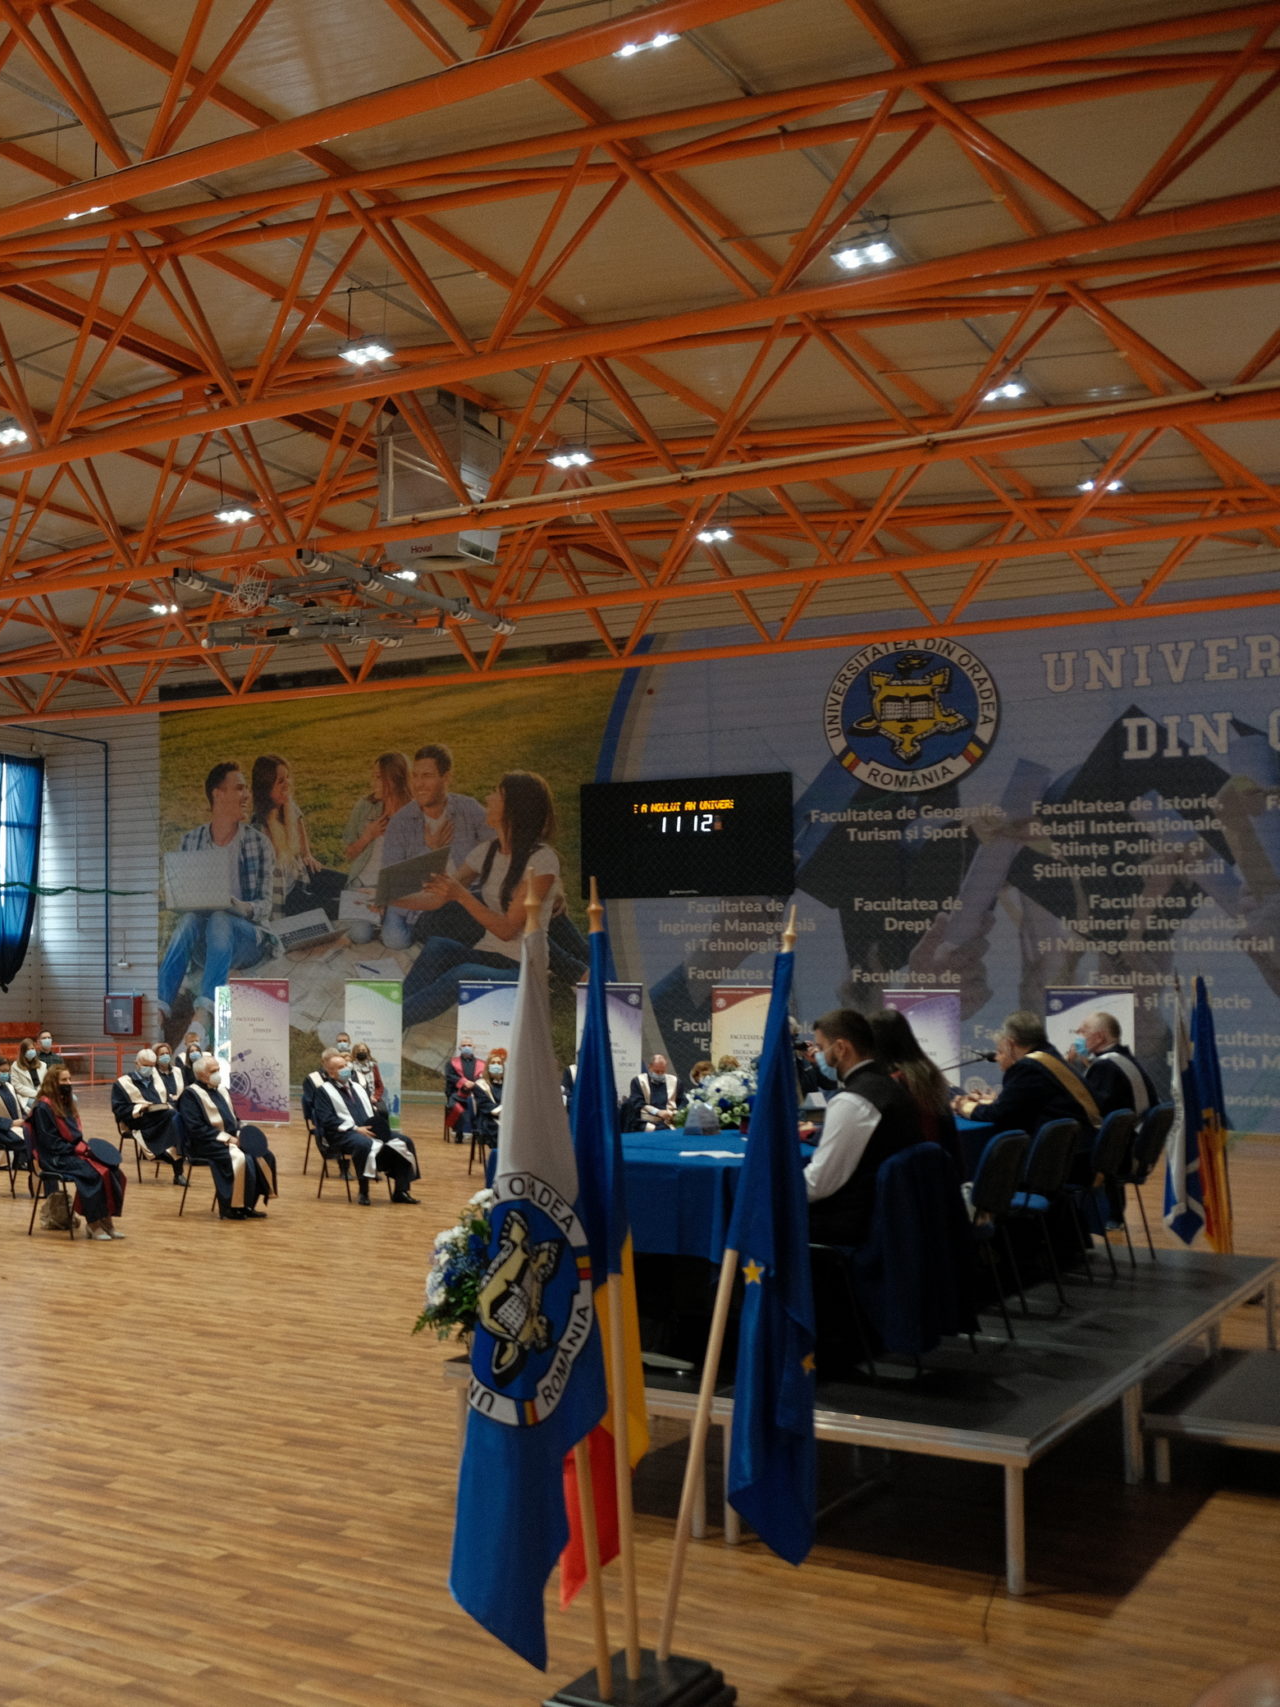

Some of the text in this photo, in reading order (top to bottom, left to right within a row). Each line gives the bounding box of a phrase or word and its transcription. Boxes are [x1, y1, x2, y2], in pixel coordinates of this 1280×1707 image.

[410, 543, 433, 554] Hoval
[825, 637, 995, 739] UNIVERSITATEA DIN ORADEA
[1122, 711, 1234, 760] DIN
[866, 764, 954, 789] ROMÂNIA
[809, 803, 1007, 823] Facultatea de Geografie,
[1031, 793, 1224, 815] Facultatea de Istorie,
[846, 824, 968, 844] Turism și Sport
[1028, 816, 1227, 840] Relații Internaționale,
[1113, 838, 1184, 855] Politice
[1188, 837, 1205, 856] și
[1111, 858, 1225, 876] Comunicării
[687, 898, 785, 914] Facultatea de
[853, 896, 963, 912] Facultatea de
[1089, 892, 1215, 910] Facultatea de
[658, 918, 816, 936] Inginerie Manageală
[884, 917, 933, 933] Drept
[1060, 913, 1248, 933] Inginerie Energetică
[1055, 938, 1177, 955] Management
[1182, 936, 1275, 952] Industrial
[687, 966, 764, 980] Facultatea
[851, 968, 962, 984] Facultatea de
[1088, 970, 1187, 986] Facultatea
[673, 1018, 712, 1032] Facul
